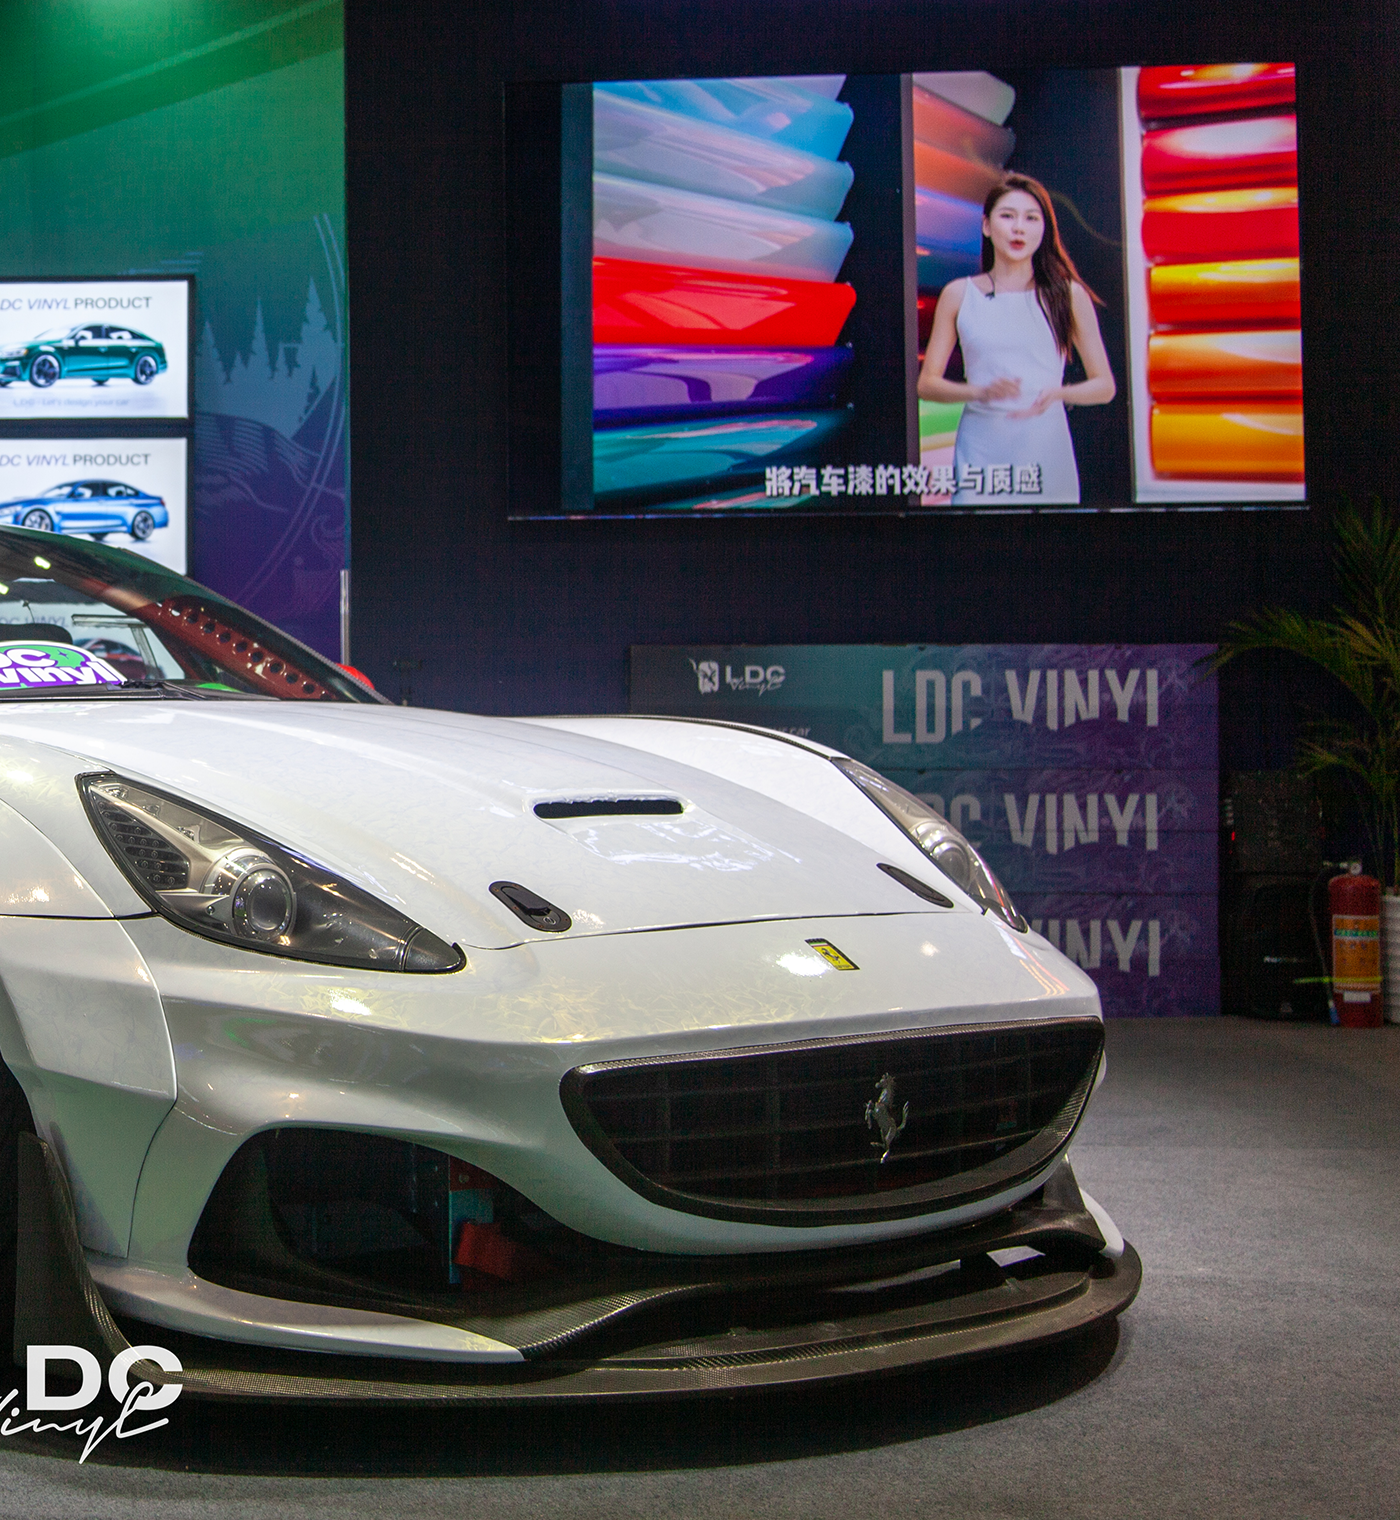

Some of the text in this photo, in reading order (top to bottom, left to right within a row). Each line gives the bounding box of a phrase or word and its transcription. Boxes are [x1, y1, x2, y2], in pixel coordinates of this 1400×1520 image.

[27, 298, 71, 310] VINYL
[74, 297, 153, 309] PRODUCT
[26, 455, 70, 466] VINYL
[73, 453, 152, 467] PRODUCT
[725, 665, 786, 684] LDC
[882, 669, 983, 744] LDC
